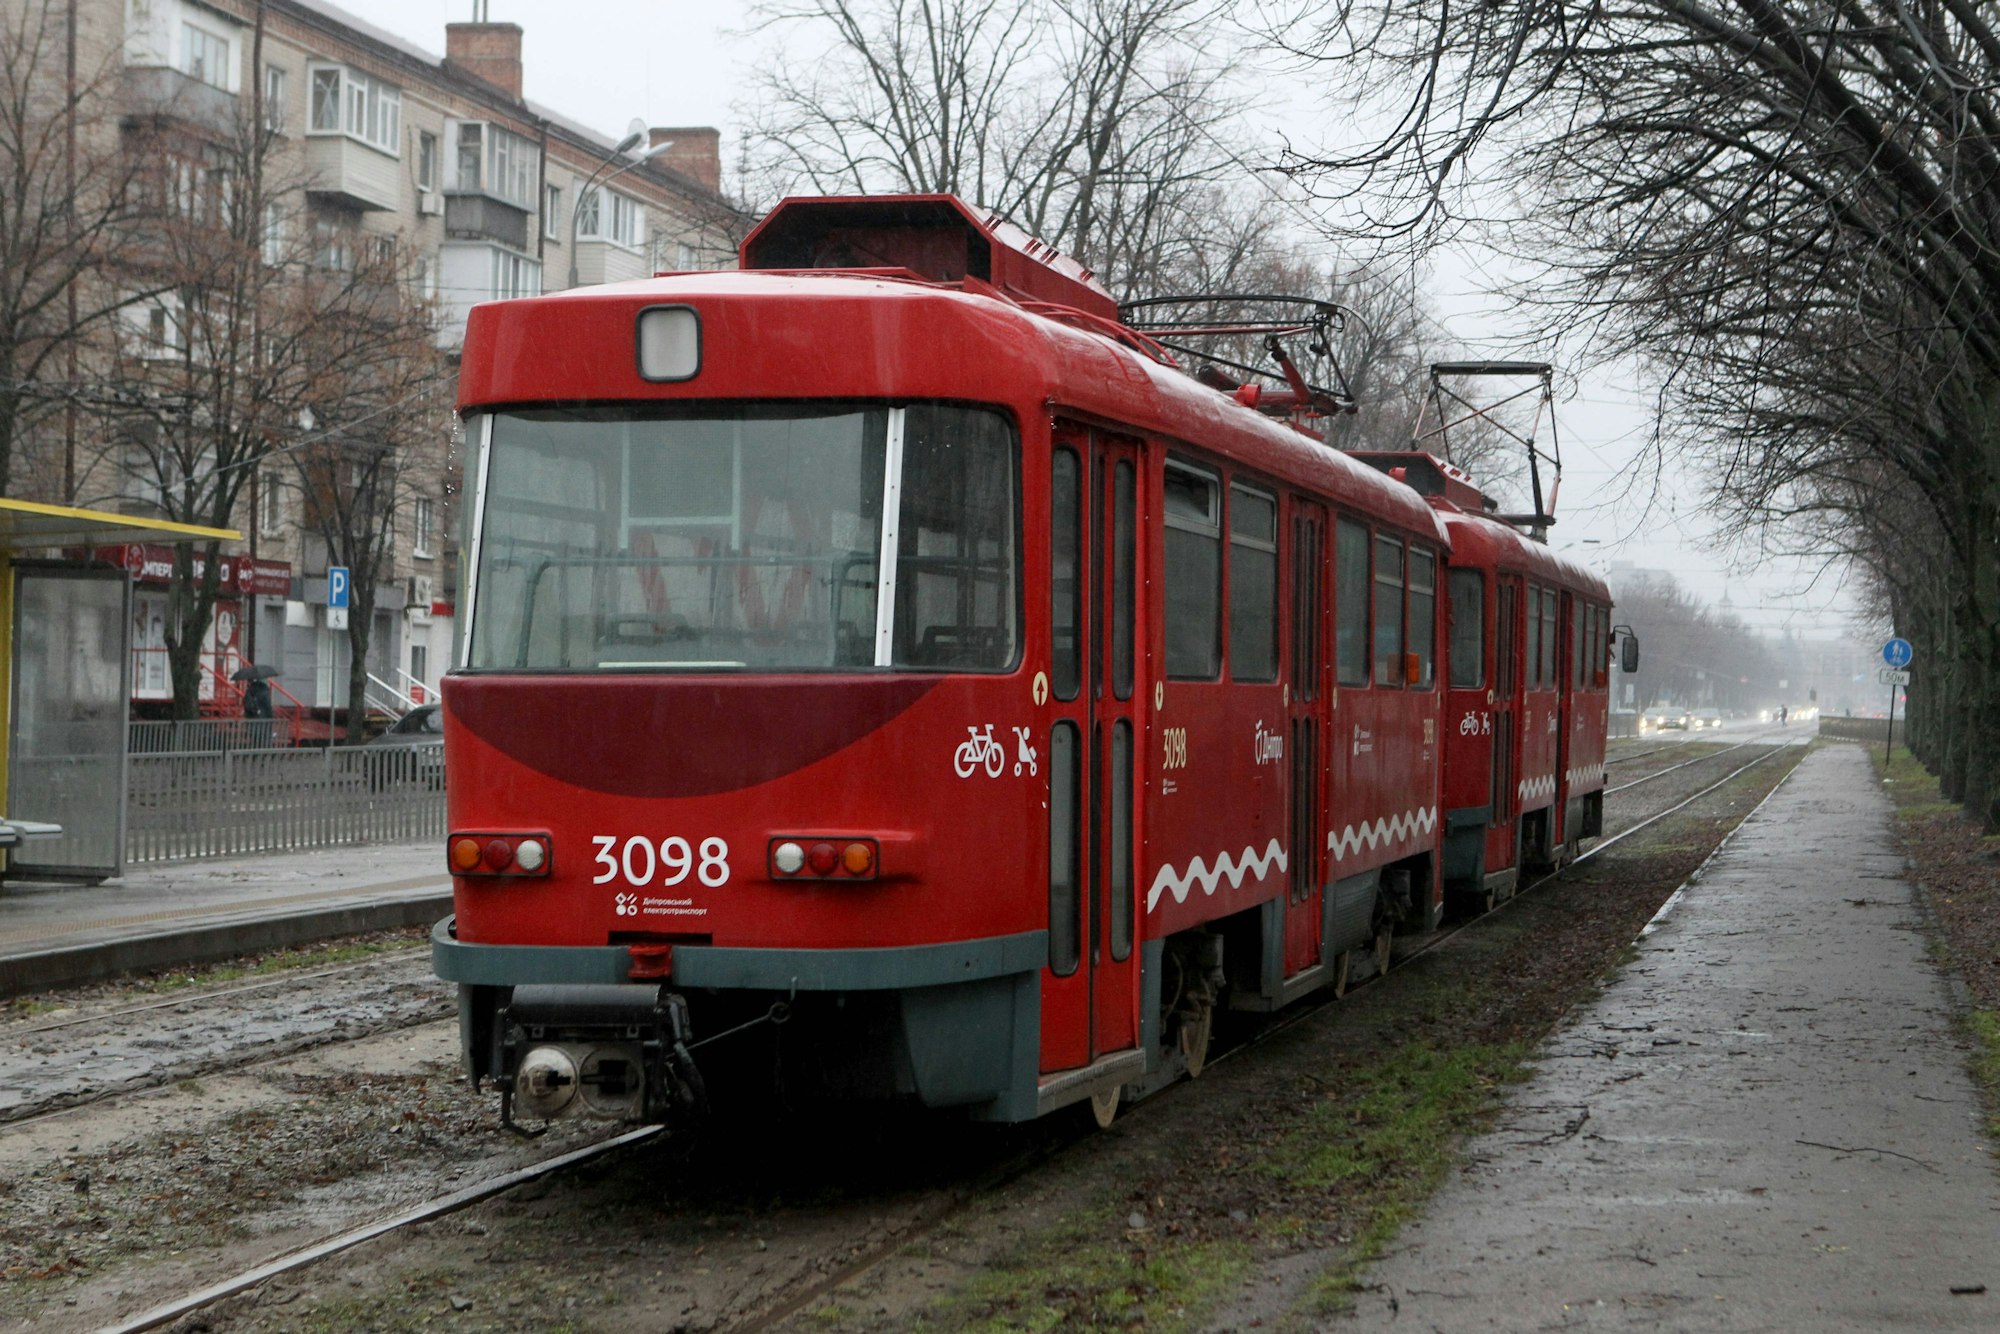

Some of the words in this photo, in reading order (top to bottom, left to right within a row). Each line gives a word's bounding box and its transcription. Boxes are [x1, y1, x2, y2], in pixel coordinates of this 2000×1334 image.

[332, 571, 345, 604] P
[1163, 727, 1187, 769] 3098
[592, 835, 731, 887] 3098
[642, 897, 693, 906] Дніпровський
[642, 907, 708, 916] електротранспорт
